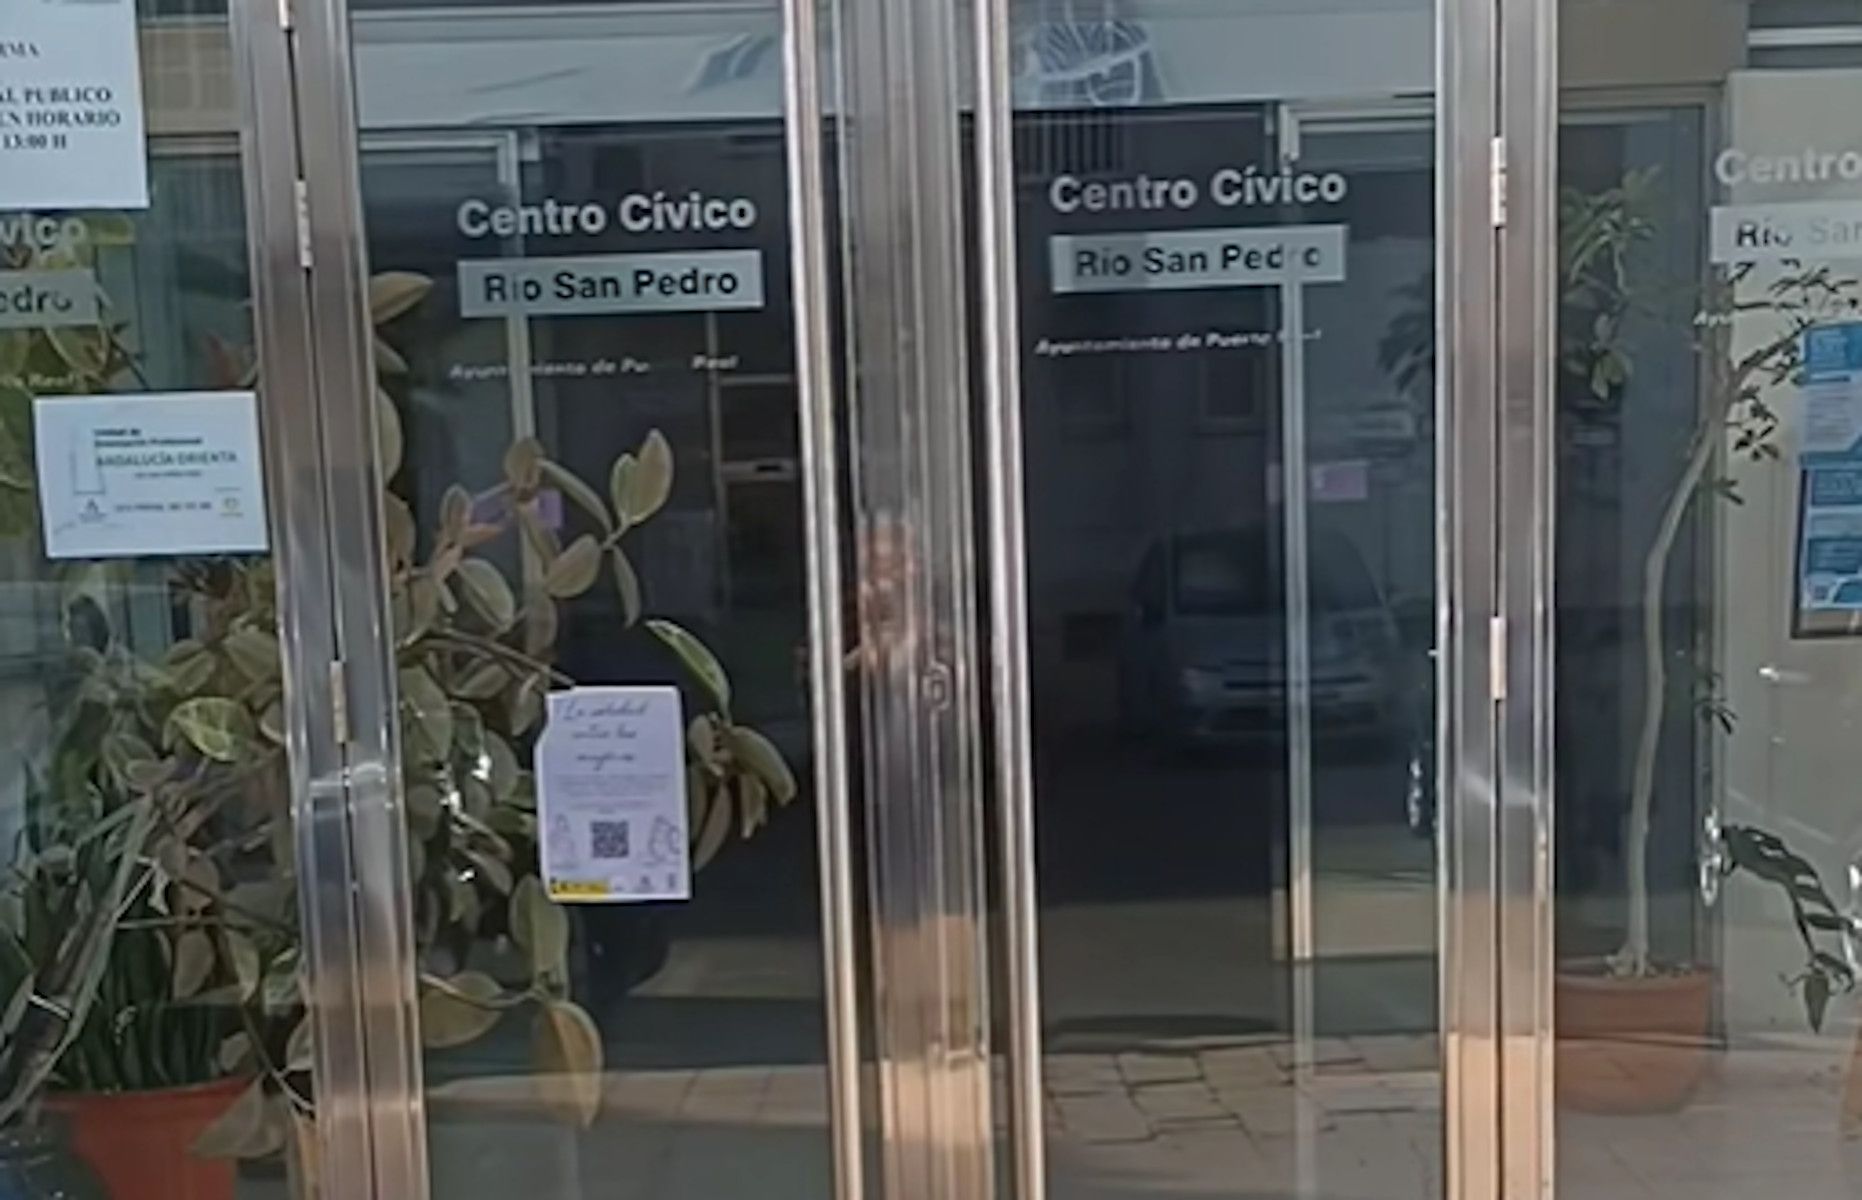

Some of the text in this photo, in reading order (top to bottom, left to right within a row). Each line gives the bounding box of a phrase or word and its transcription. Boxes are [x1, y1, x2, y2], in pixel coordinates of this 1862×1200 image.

[24, 86, 112, 104] PUBLICO
[26, 109, 121, 127] HORARIO
[1050, 165, 1346, 213] Centro Cívico
[457, 191, 756, 237] Centro Cívico
[1143, 247, 1207, 274] San
[1221, 243, 1321, 270] Pedo
[553, 272, 621, 299] San
[633, 266, 739, 298] Pedro
